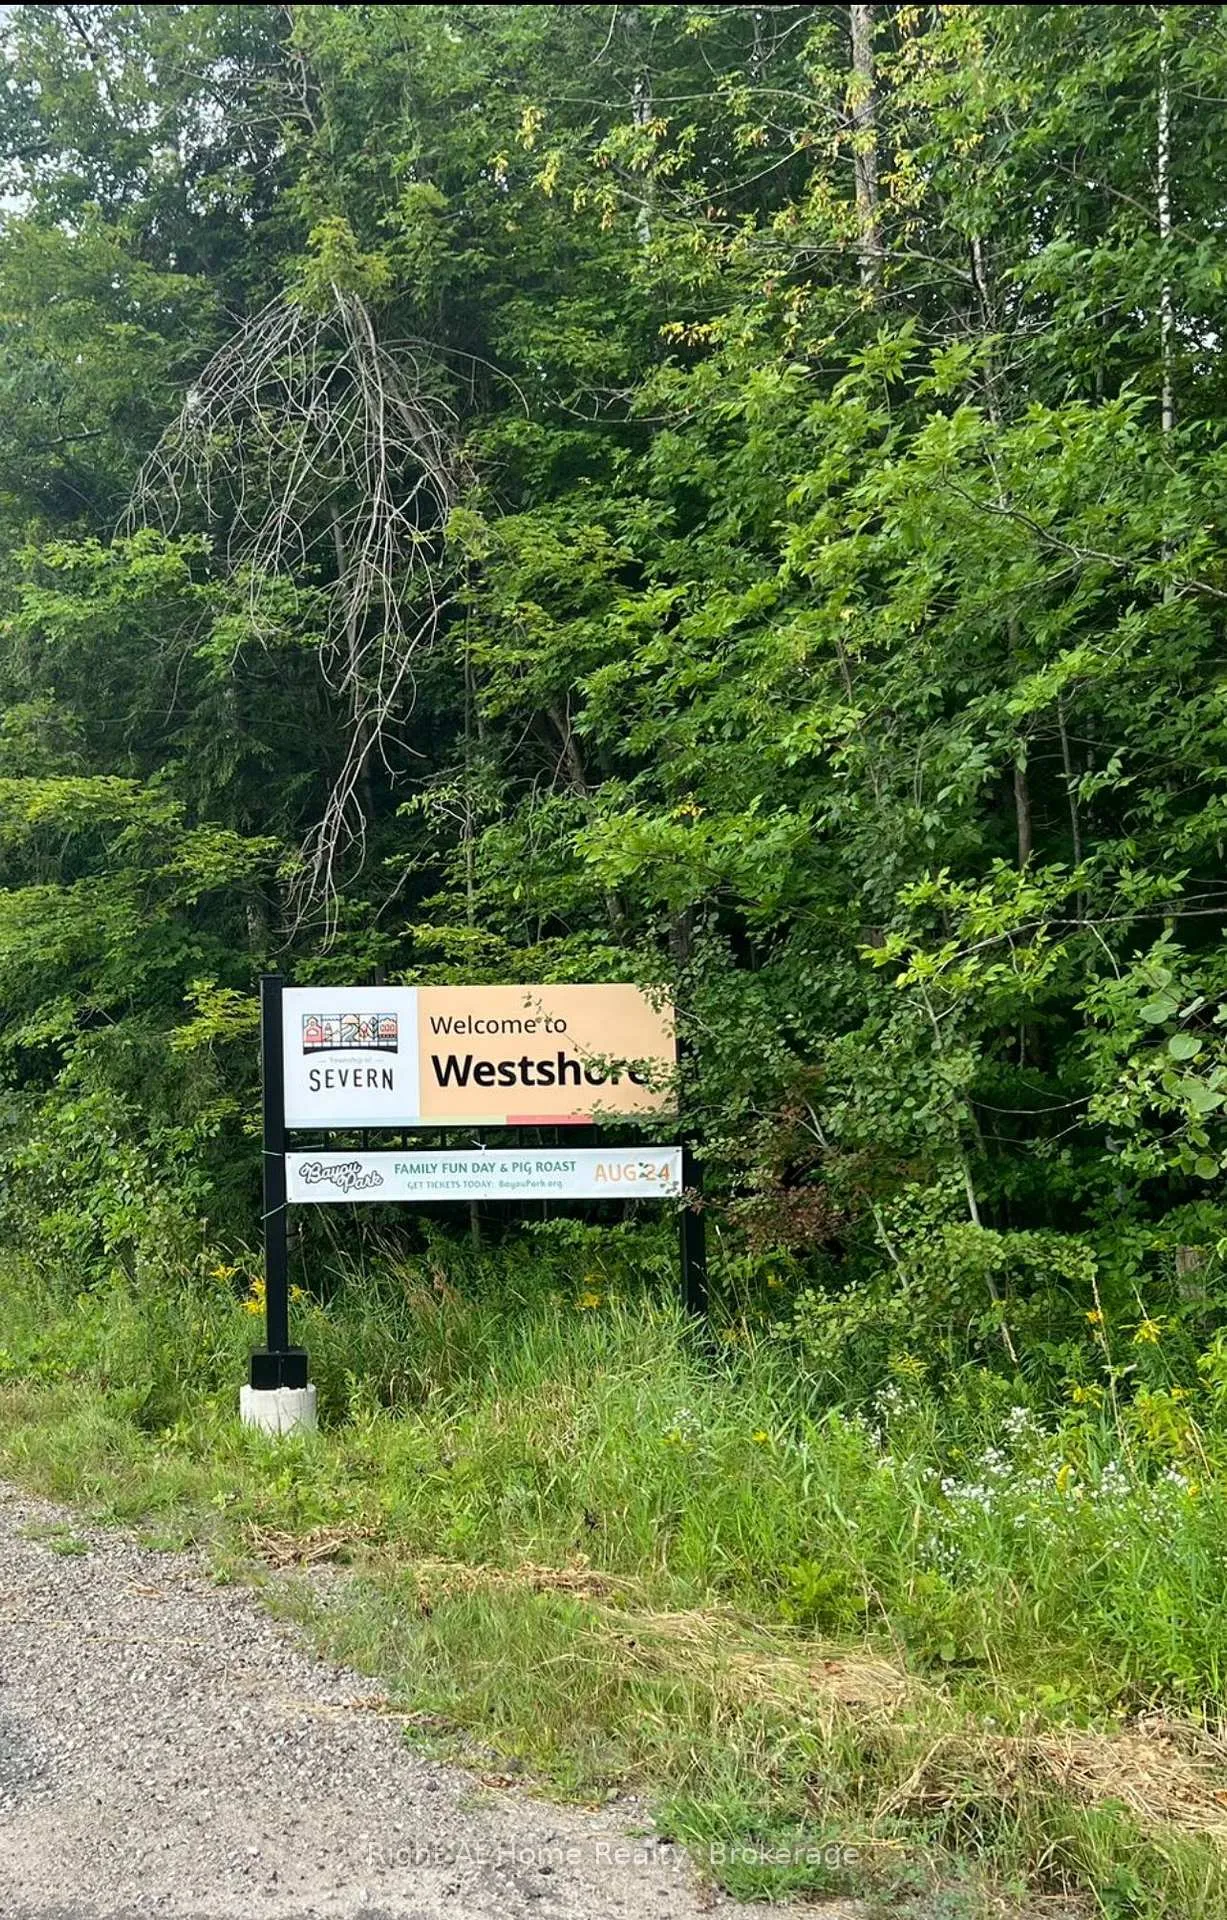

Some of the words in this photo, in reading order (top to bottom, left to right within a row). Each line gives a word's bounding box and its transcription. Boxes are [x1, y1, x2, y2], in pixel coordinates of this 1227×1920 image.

[430, 1015, 536, 1035] Welcome
[545, 1016, 567, 1033] to
[309, 1068, 393, 1092] SEVERN
[299, 1161, 362, 1184] Bayou
[394, 1162, 438, 1175] FAMILY
[442, 1162, 468, 1174] FUN
[471, 1161, 496, 1173] DAY
[500, 1163, 508, 1173] &
[512, 1161, 532, 1175] PIG
[536, 1160, 576, 1172] ROAST
[595, 1163, 636, 1182] AUG
[646, 1163, 670, 1182] 24
[336, 1170, 384, 1194] Park
[407, 1180, 423, 1190] GET
[426, 1180, 461, 1190] TICKETS
